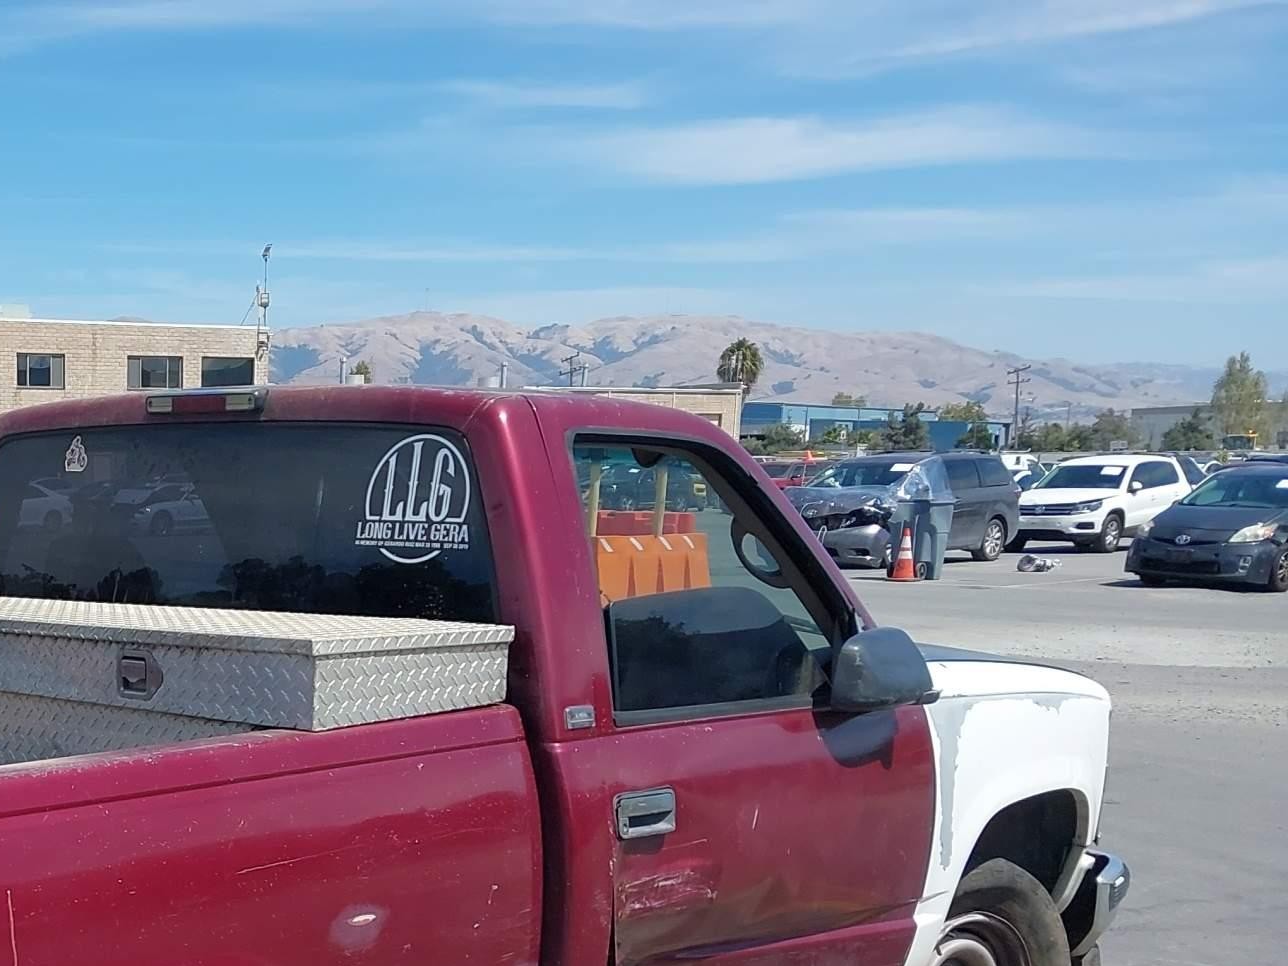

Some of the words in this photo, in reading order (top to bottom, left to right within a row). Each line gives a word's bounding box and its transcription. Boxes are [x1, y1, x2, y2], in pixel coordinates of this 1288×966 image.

[381, 441, 455, 522] LLG
[356, 521, 392, 539] LONG
[394, 522, 428, 541] LIVE
[430, 523, 469, 543] GERA
